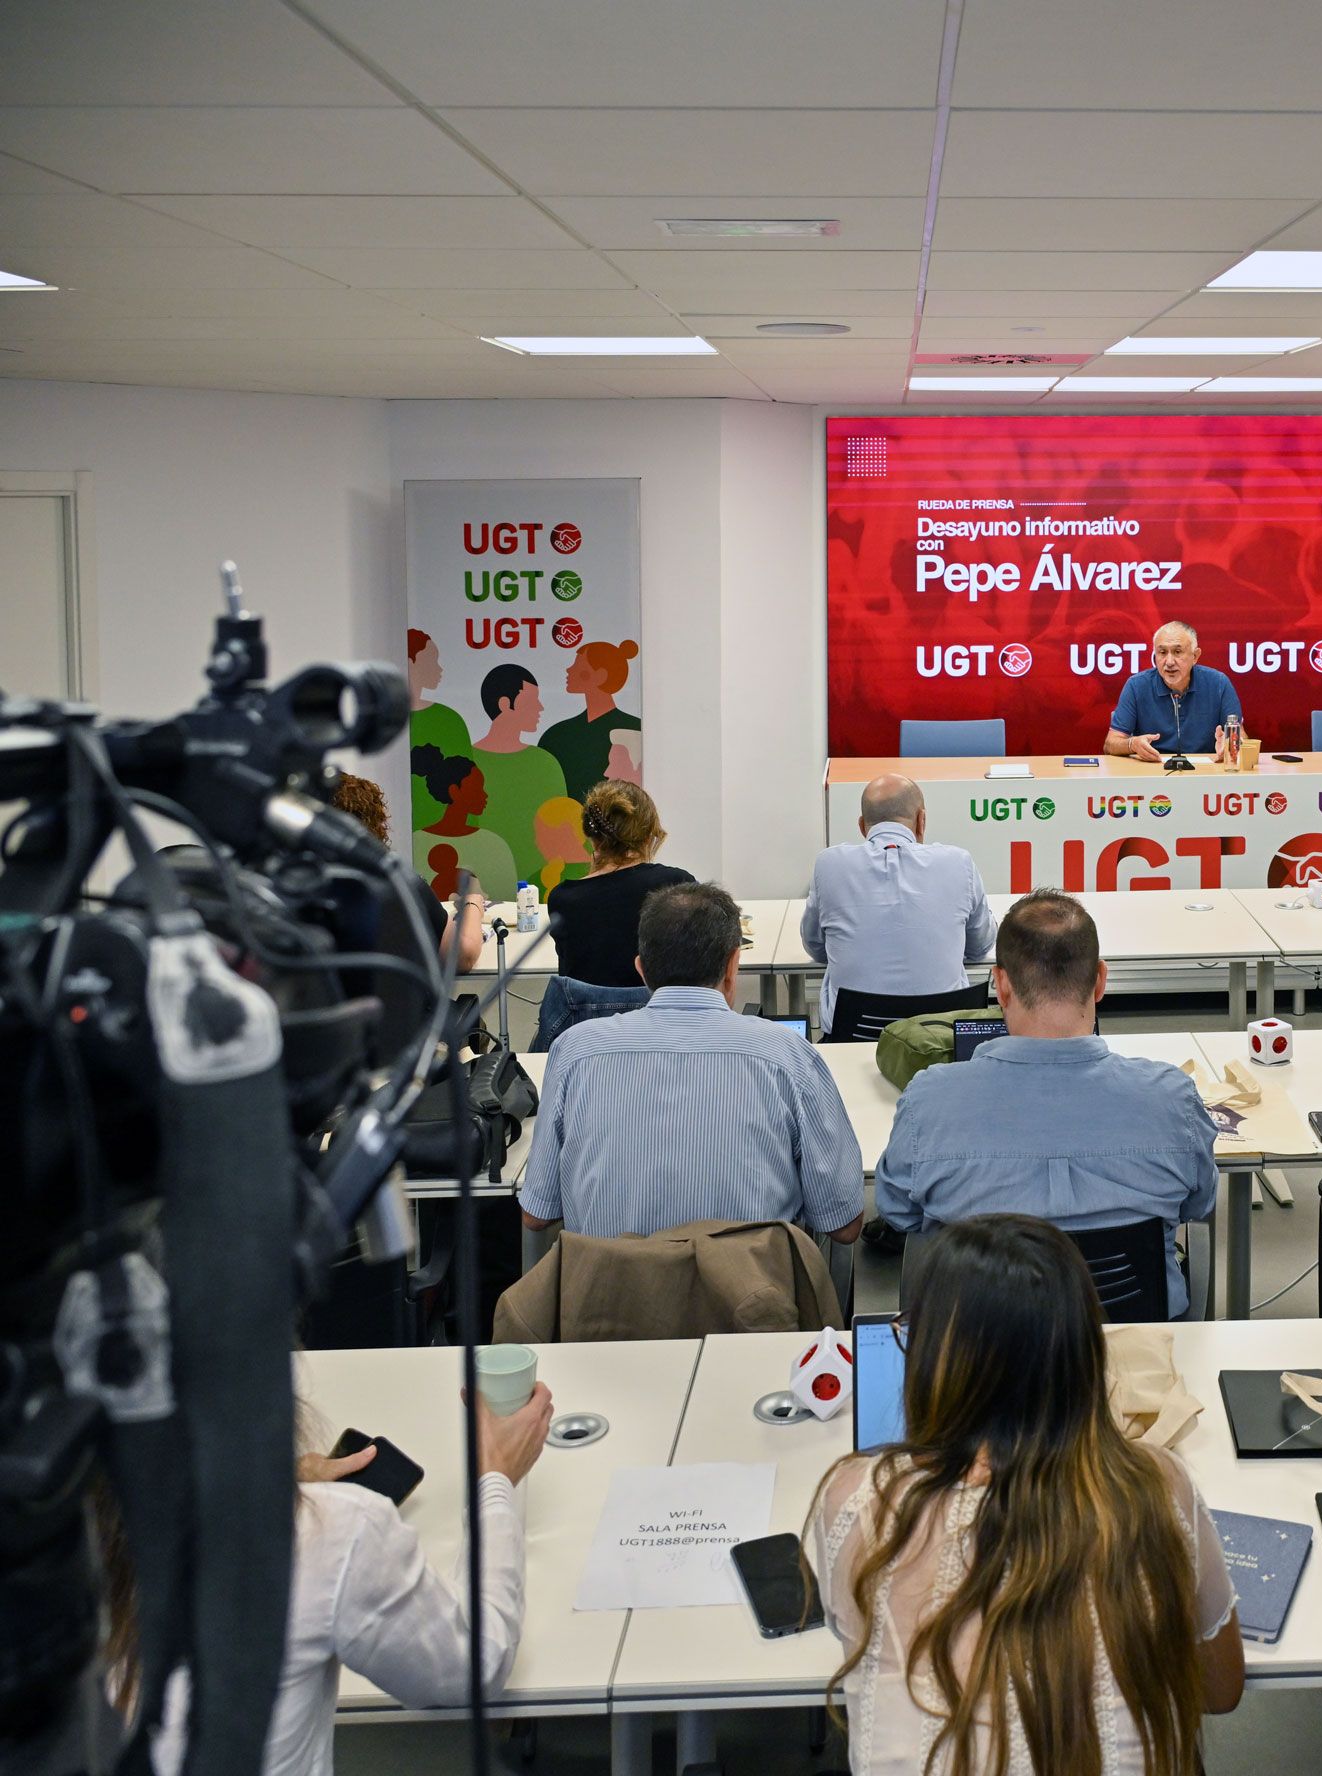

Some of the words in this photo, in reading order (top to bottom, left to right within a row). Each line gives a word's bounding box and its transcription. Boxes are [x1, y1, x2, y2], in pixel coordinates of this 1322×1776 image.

[917, 499, 954, 510] RUEDA
[955, 499, 970, 510] DE
[972, 499, 1014, 510] PRENSA
[463, 522, 543, 555] UGT
[917, 517, 1021, 542] Desayuno
[1025, 516, 1140, 536] informativo
[916, 538, 944, 551] con
[916, 554, 1021, 602] Pepe
[1029, 543, 1182, 591] Álvarez
[464, 570, 544, 602] UGT
[465, 617, 545, 649] UGT
[916, 644, 994, 678] UGT
[1070, 642, 1147, 675] UGT
[1228, 640, 1306, 674] UGT
[970, 797, 1028, 822] UGT
[1087, 795, 1144, 819] UGT
[1203, 792, 1260, 816] UGT
[669, 1509, 703, 1519] WI-FI
[638, 1524, 671, 1533] SALA
[675, 1523, 727, 1532] PRENSA
[619, 1536, 741, 1546] UGT1888@prensa
